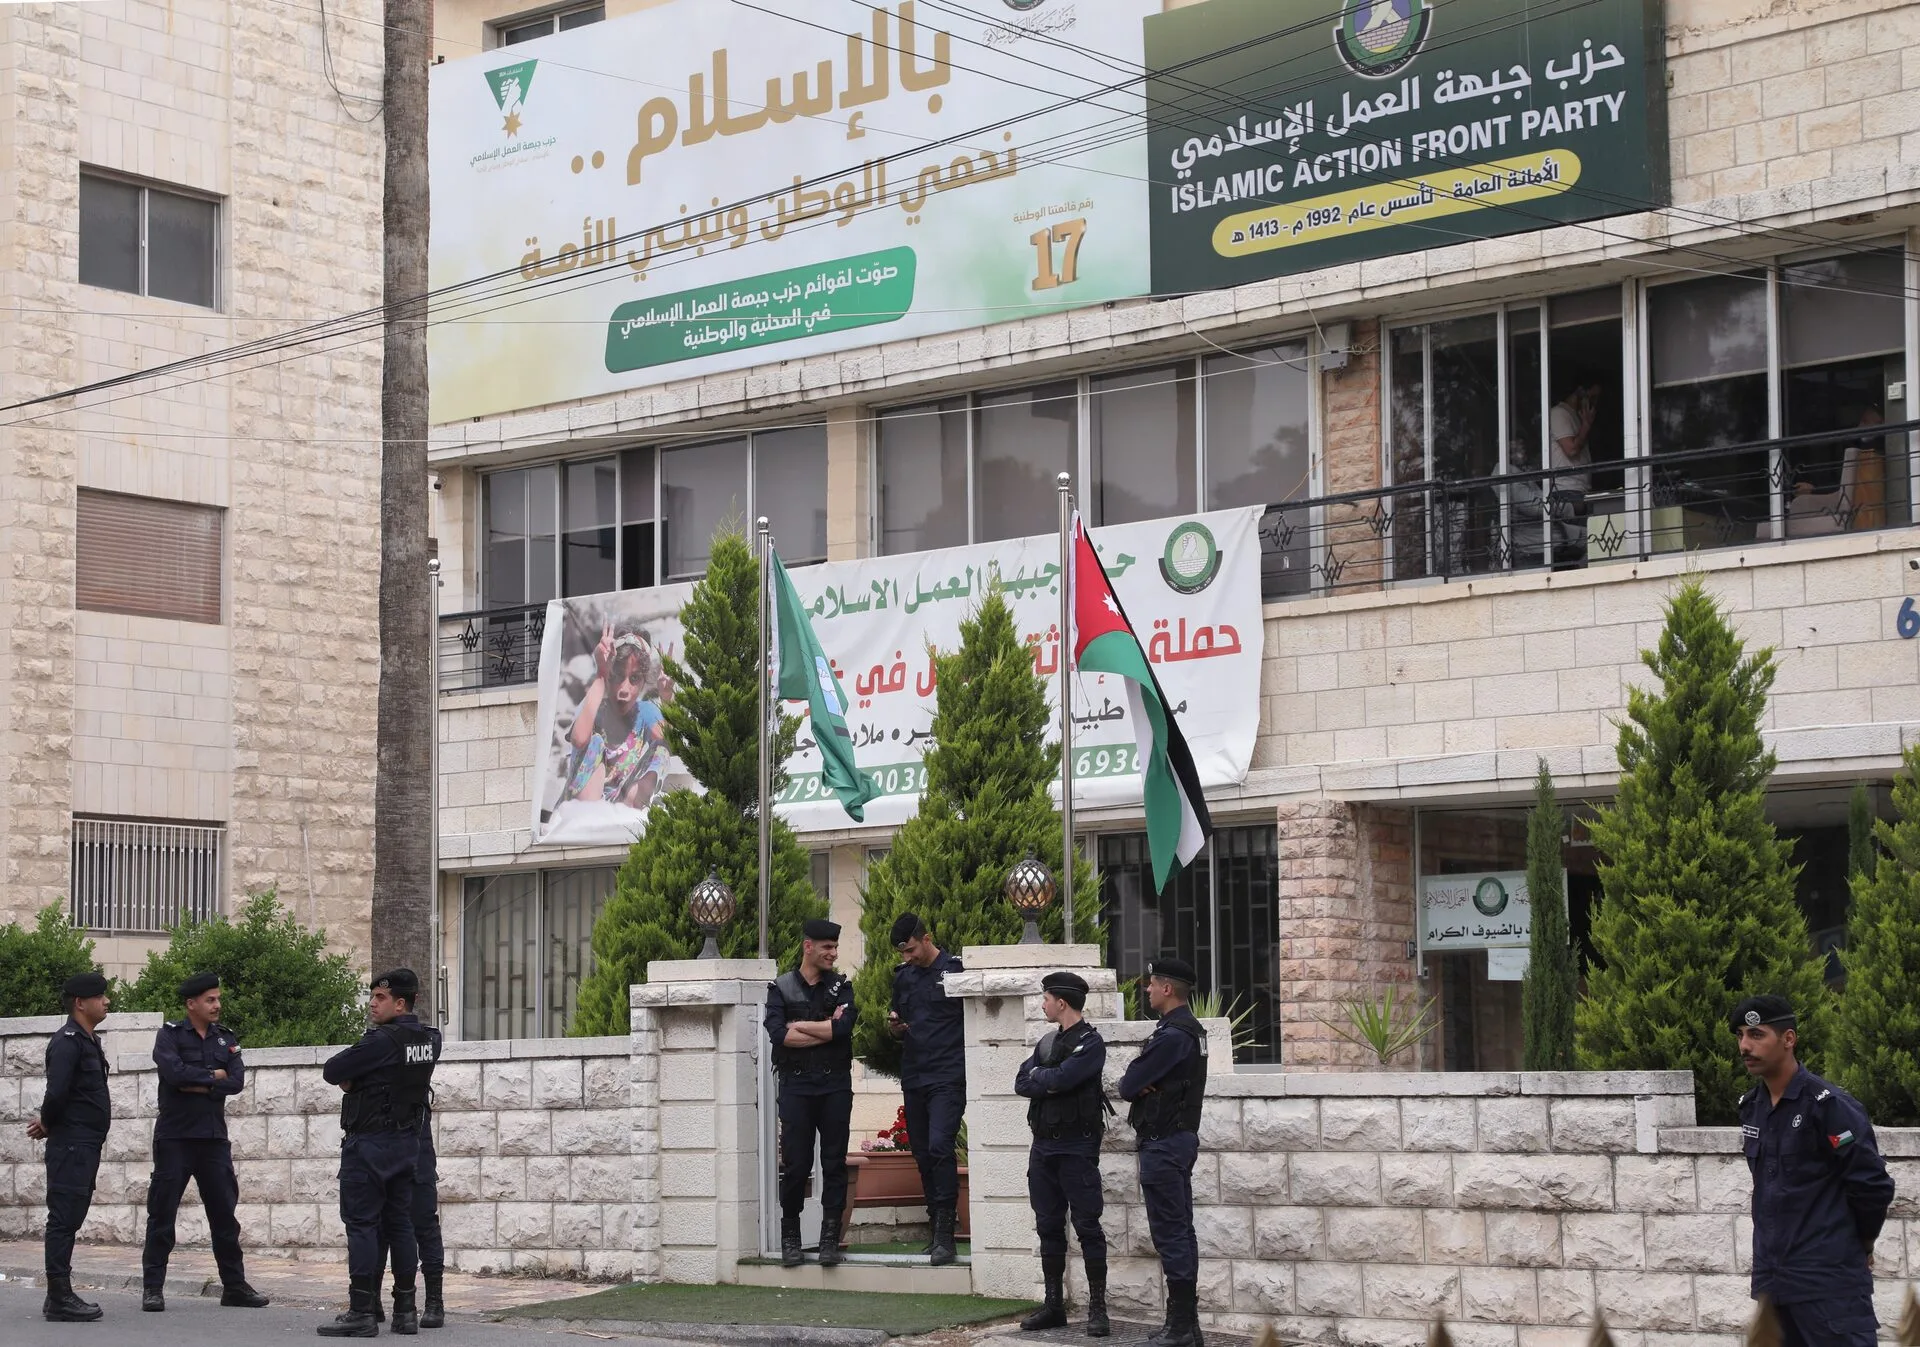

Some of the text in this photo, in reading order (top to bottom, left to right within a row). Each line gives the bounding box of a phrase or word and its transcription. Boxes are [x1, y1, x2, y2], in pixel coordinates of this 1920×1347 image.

[627, 0, 951, 186] بالإسلام
[1171, 38, 1625, 180] حزب جبهة العمل الإسلامي
[1171, 91, 1627, 214] ISLAMIC ACTION FRONT PARTY
[1453, 174, 1502, 199] العامة
[1508, 156, 1559, 189] الأمانة
[520, 131, 1018, 282] نحمي الوطن ونبني الأمة
[1305, 206, 1342, 228] 1992
[1347, 201, 1376, 225] عام
[1380, 183, 1434, 218] تأسس
[1249, 219, 1280, 239] 1413
[1029, 217, 1087, 291] 17
[731, 289, 770, 309] جبهة
[772, 280, 801, 303] حزب
[804, 268, 852, 299] لقوائم
[621, 303, 683, 340] الإسلامي
[686, 293, 728, 322] العمل
[683, 303, 831, 350] في المحلية والوطنية
[904, 564, 982, 615] العمل
[1149, 618, 1242, 664] حملة
[856, 650, 906, 709] في
[1427, 923, 1523, 942] بالضيوف الكرام
[406, 1044, 433, 1063] POLICE
